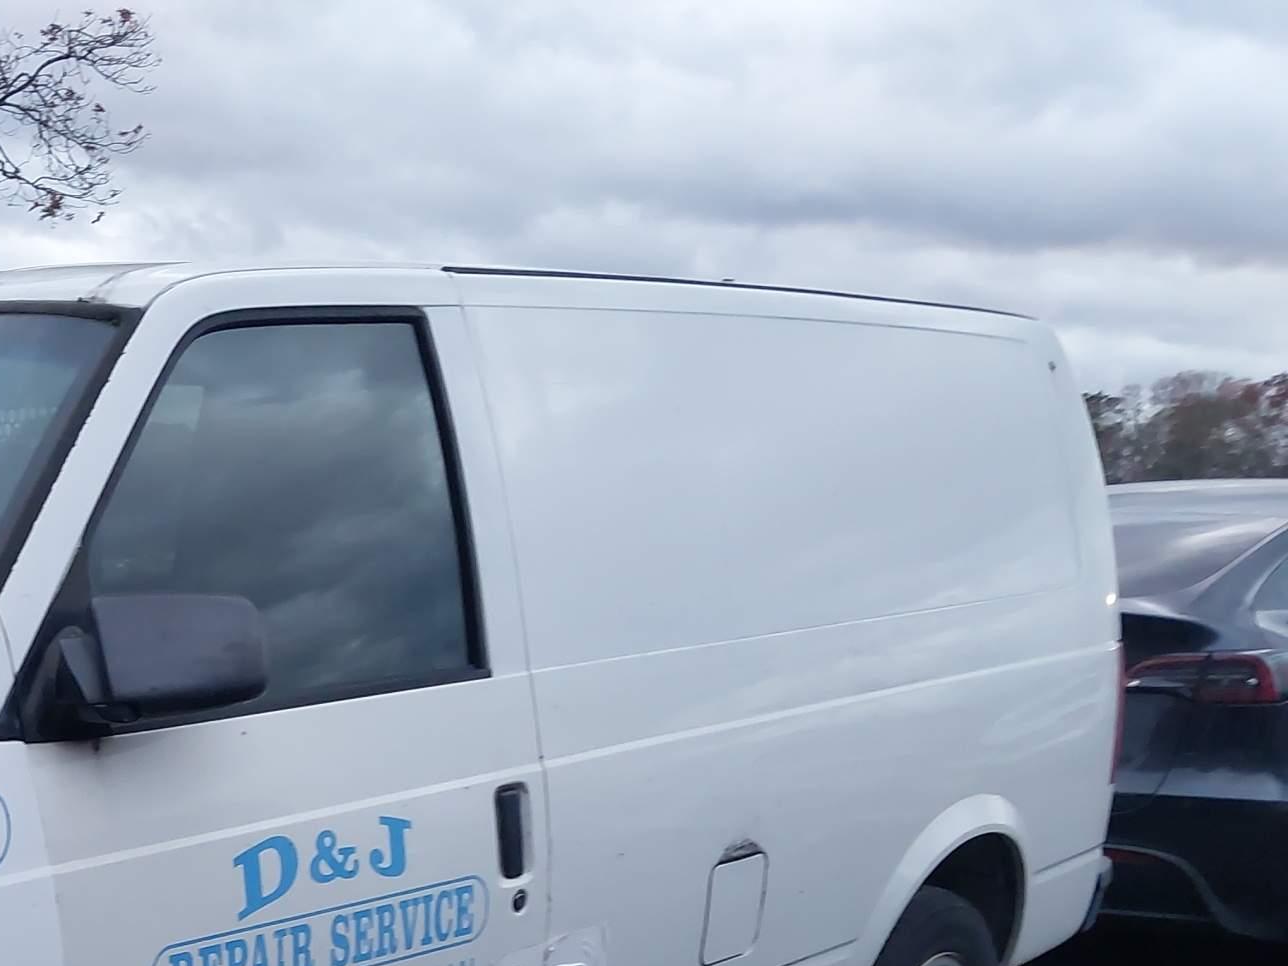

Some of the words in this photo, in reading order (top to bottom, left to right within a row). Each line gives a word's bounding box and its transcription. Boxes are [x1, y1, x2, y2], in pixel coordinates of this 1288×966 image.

[233, 834, 298, 921] D
[310, 829, 359, 883] &
[369, 816, 412, 877] J
